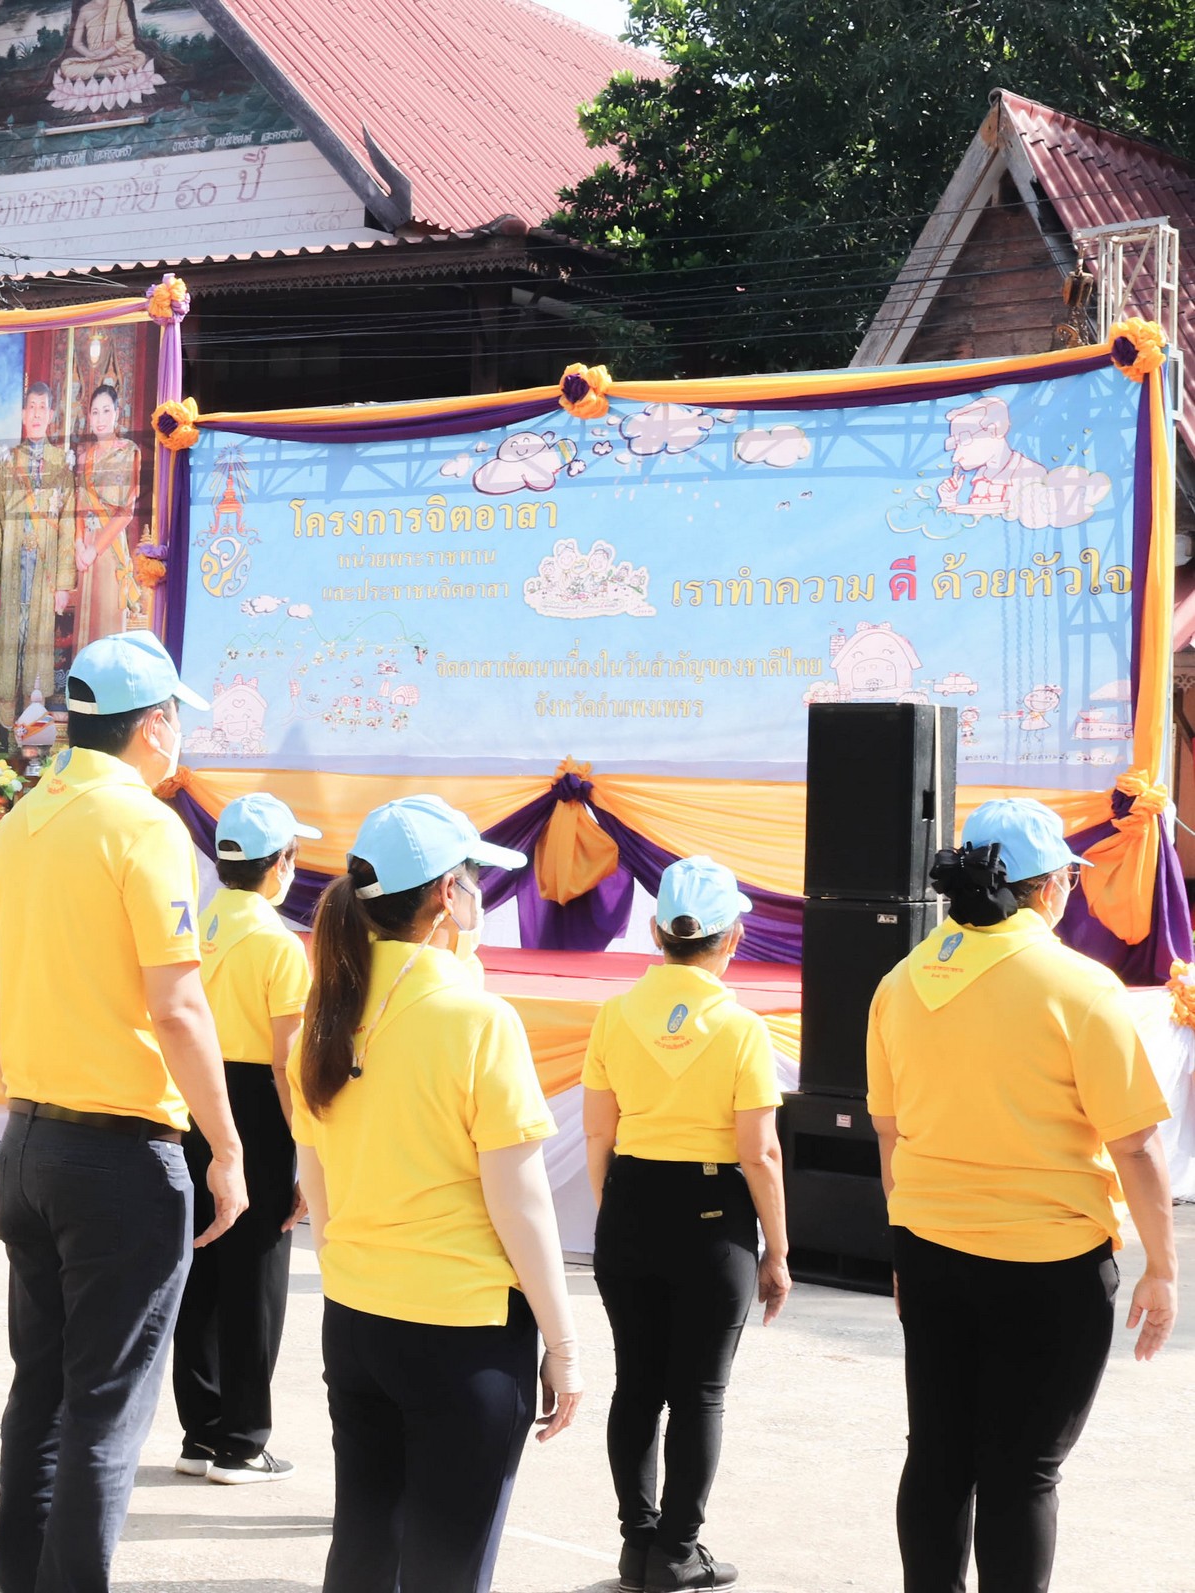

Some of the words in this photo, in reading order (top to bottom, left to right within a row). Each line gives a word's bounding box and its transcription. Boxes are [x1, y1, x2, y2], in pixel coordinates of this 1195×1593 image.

[288, 493, 559, 538] โครงการจิตอาสา
[337, 545, 497, 570] หน่วยพระราชทาน
[322, 576, 510, 602] และประชาชนจิตอาสา
[671, 565, 877, 608] เราทำความ
[887, 555, 918, 602] ดี
[931, 546, 1133, 601] ด้วยหัวใจ
[534, 691, 705, 719] จังหวัดกำแพงเพชร
